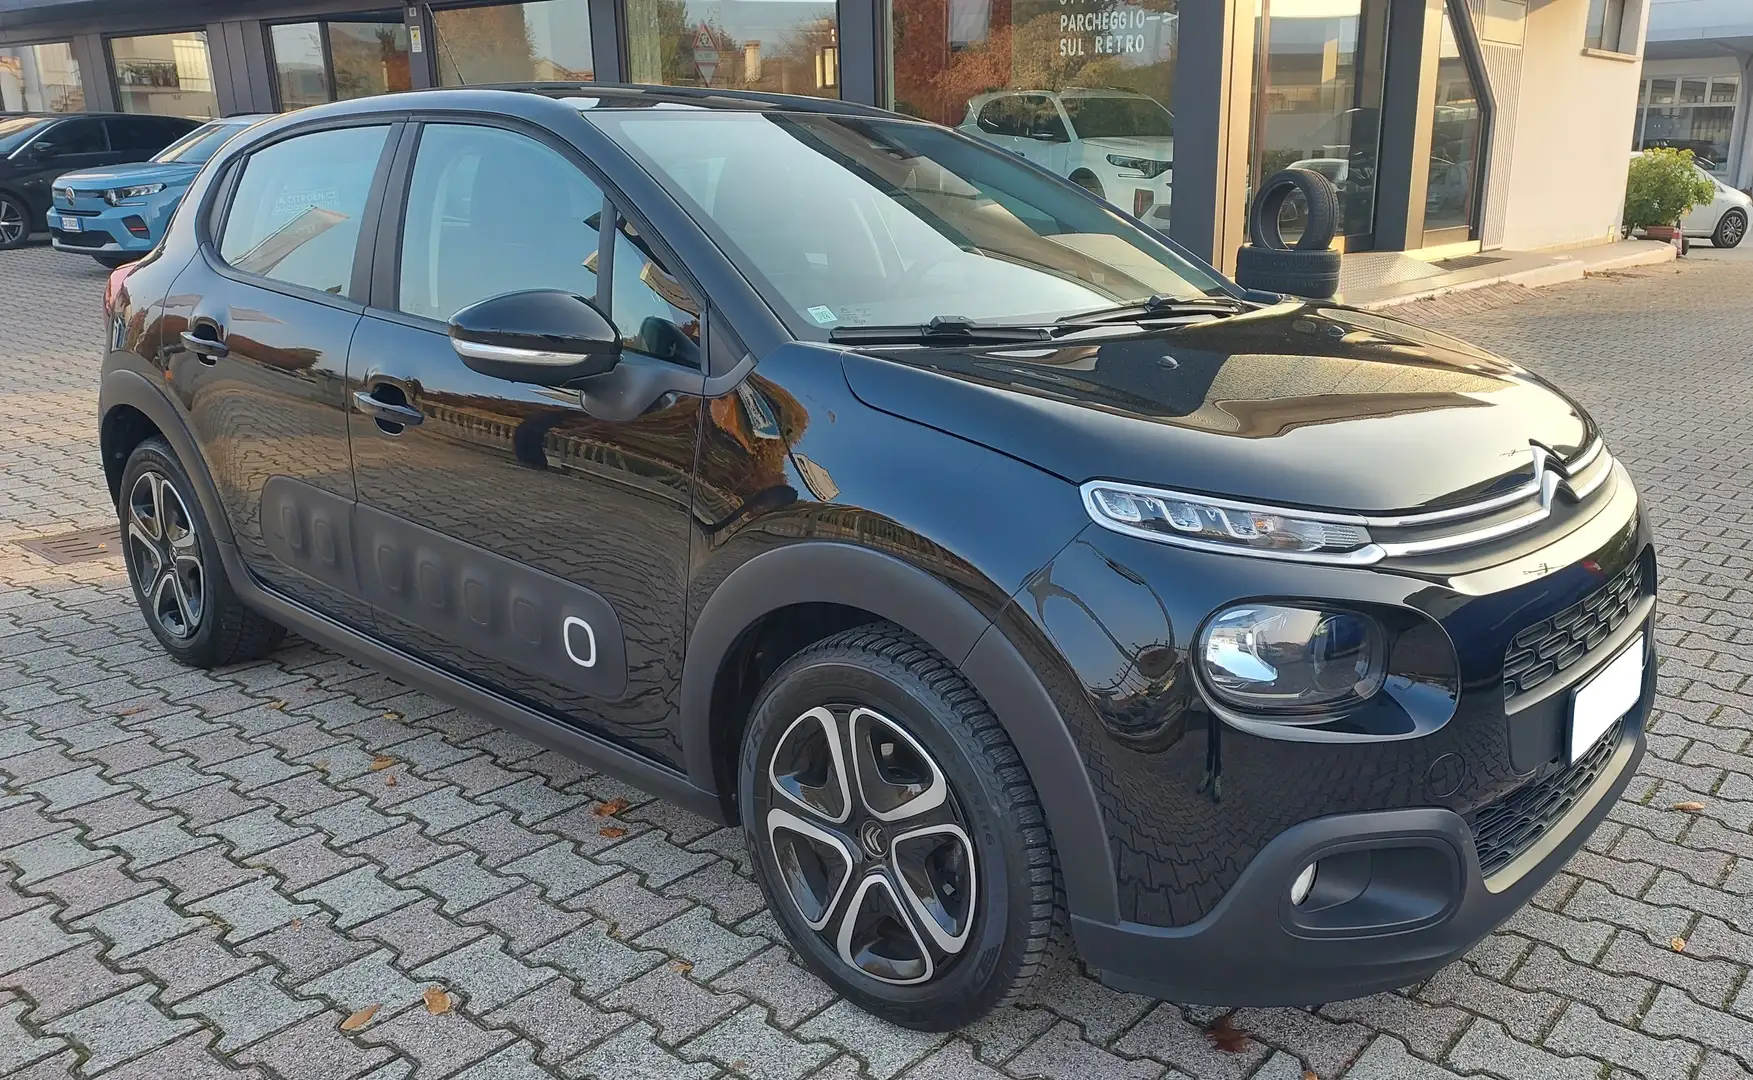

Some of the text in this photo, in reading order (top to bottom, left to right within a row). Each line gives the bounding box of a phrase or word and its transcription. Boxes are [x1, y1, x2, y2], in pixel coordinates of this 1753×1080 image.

[1060, 9, 1145, 32] PARCHEGGIO
[1060, 33, 1145, 57] SUL RETRO
